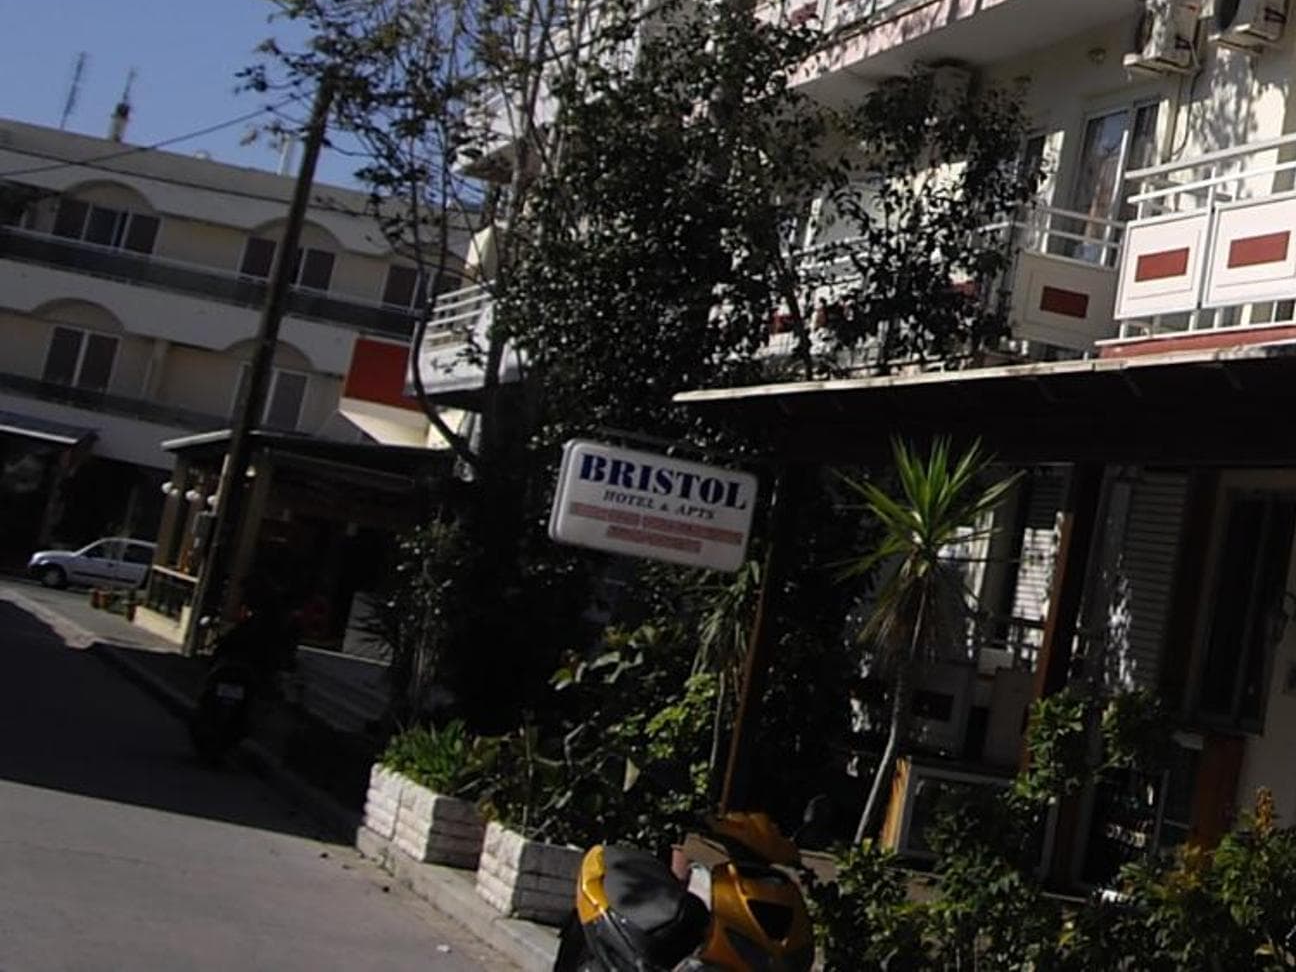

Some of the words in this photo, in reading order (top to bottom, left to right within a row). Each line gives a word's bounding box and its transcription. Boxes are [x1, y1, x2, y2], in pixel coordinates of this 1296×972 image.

[579, 453, 747, 511] BRISTOL
[603, 490, 654, 510] HOTEL
[675, 505, 715, 520] APTS
